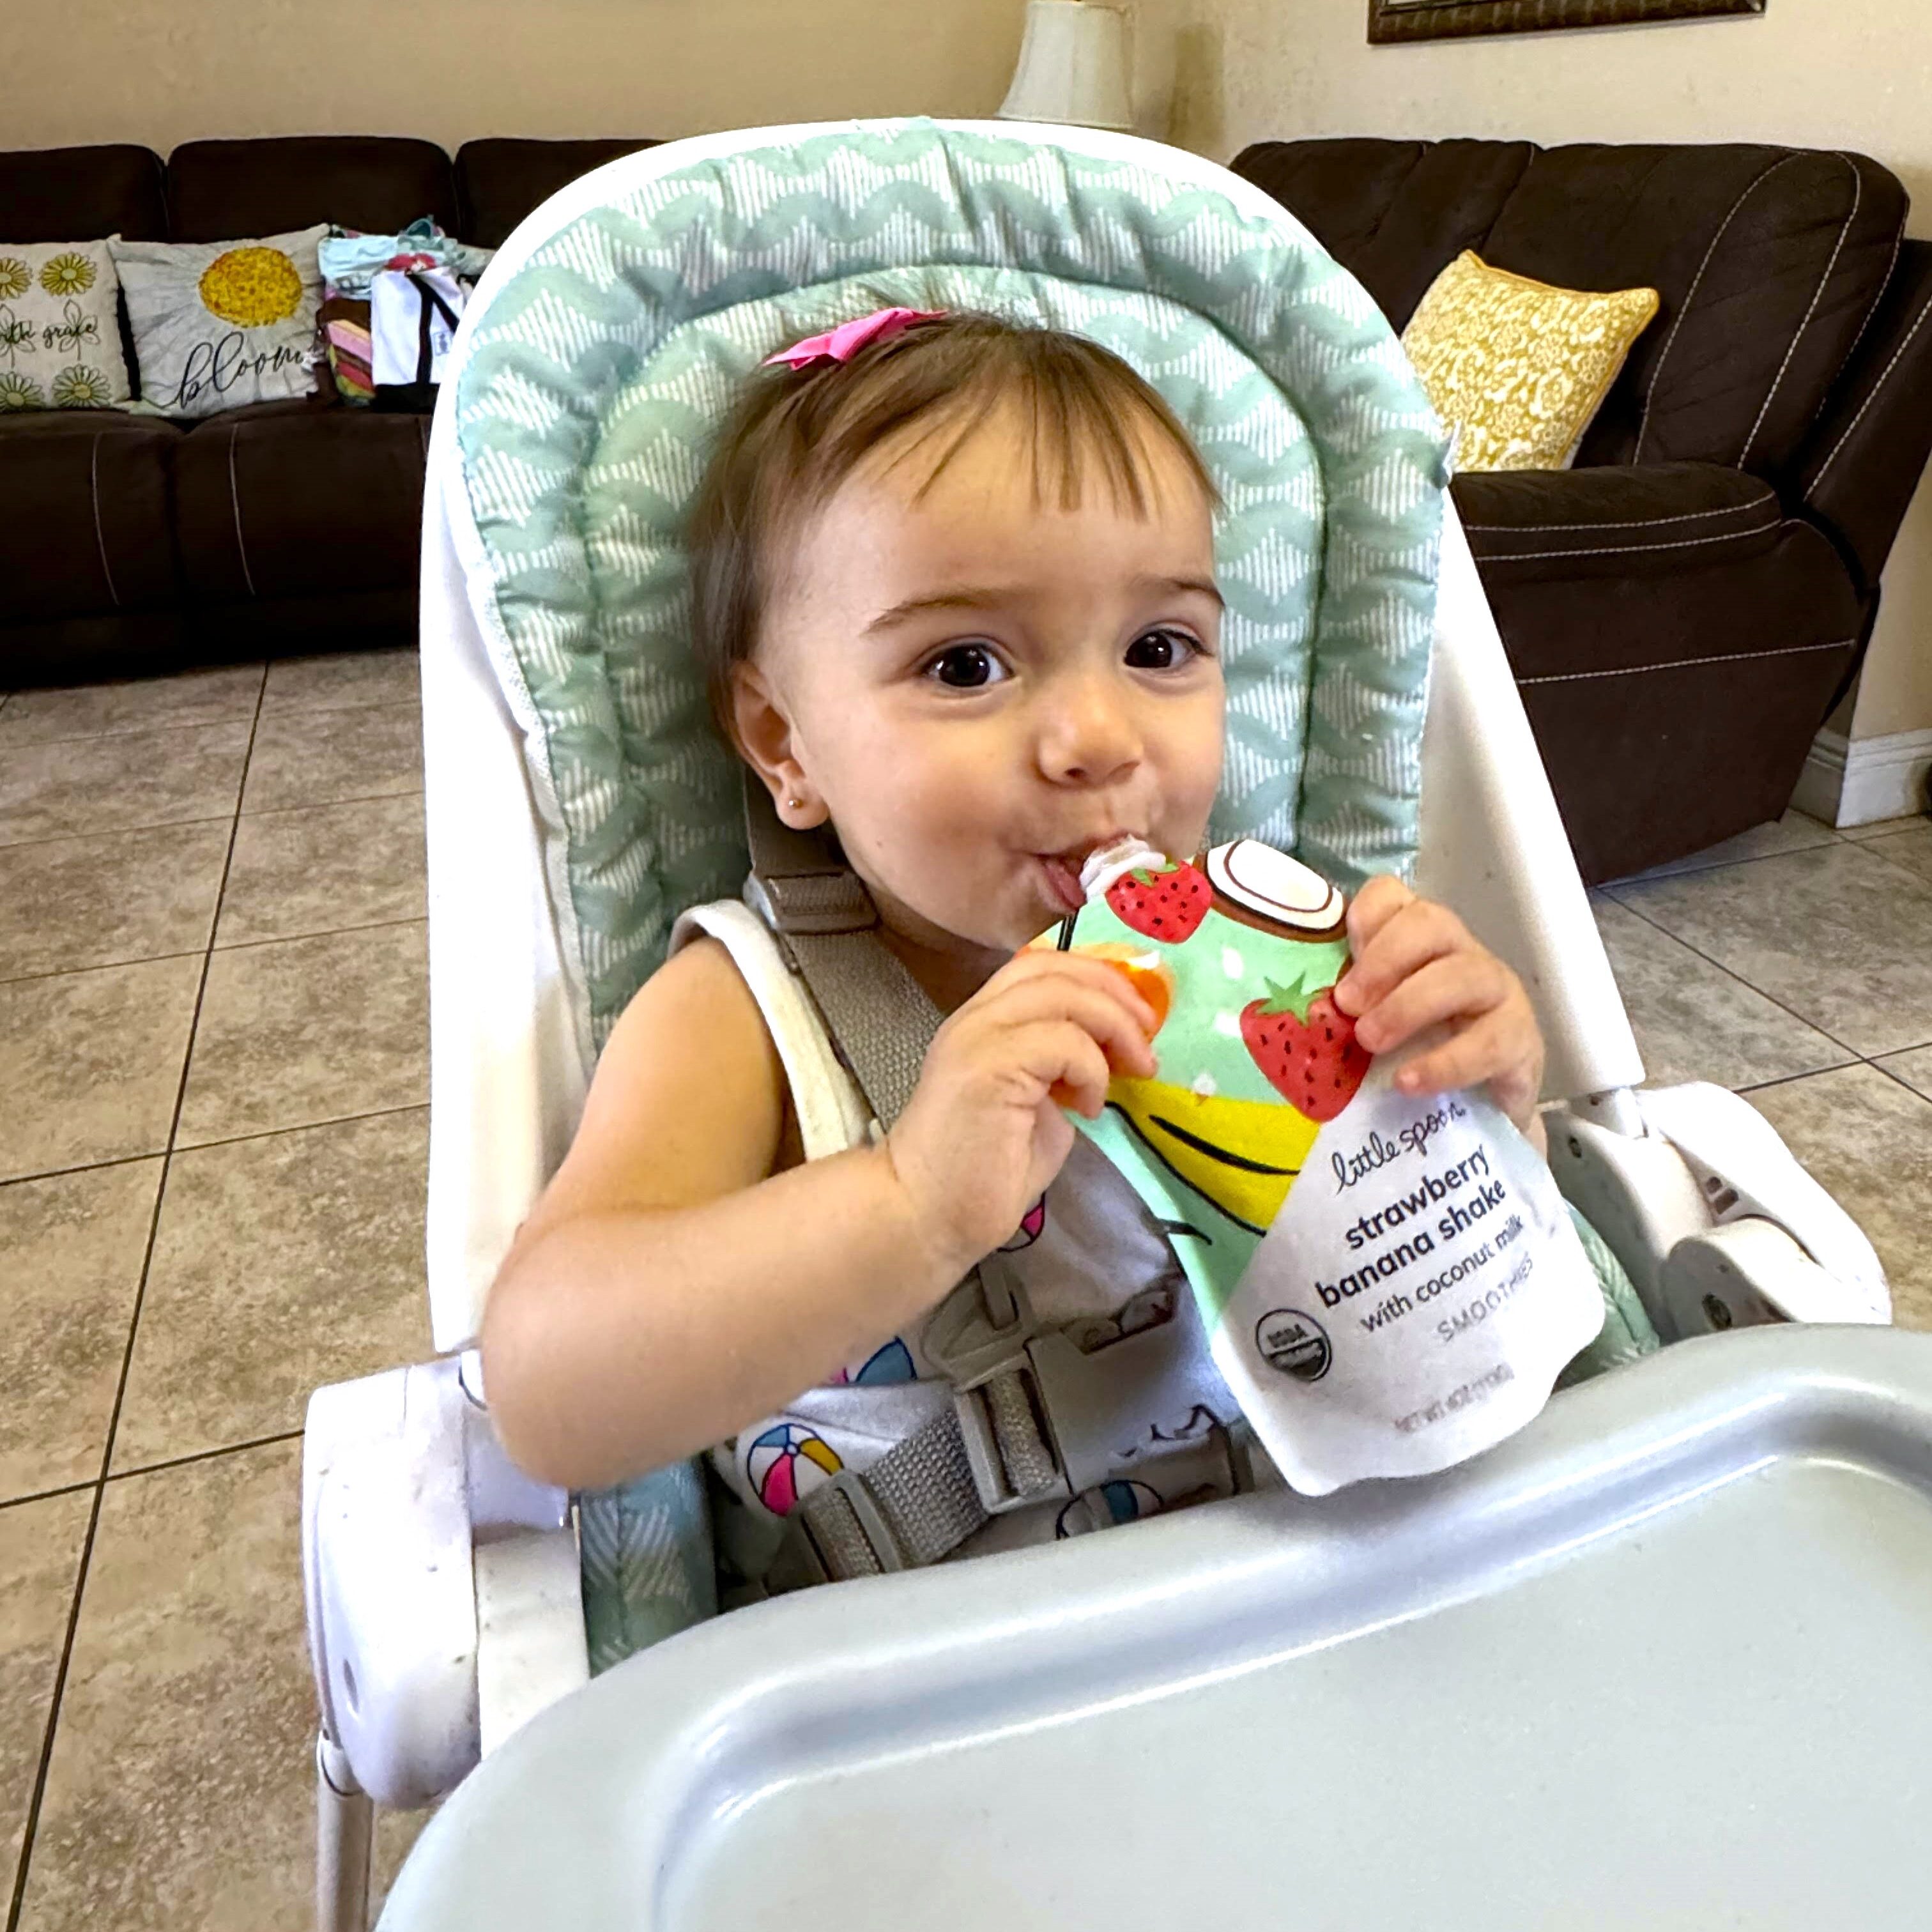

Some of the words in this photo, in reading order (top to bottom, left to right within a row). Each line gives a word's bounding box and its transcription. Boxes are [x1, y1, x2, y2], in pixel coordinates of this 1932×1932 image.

[0, 320, 36, 344] ith
[169, 331, 304, 410] bloom
[1331, 1131, 1400, 1197] little
[1399, 1101, 1467, 1157] spoon
[1346, 1144, 1489, 1250] strawberry
[1315, 1231, 1436, 1308] banana
[1438, 1180, 1506, 1240] shake
[1360, 1294, 1413, 1332] with
[1416, 1242, 1495, 1303] coconut
